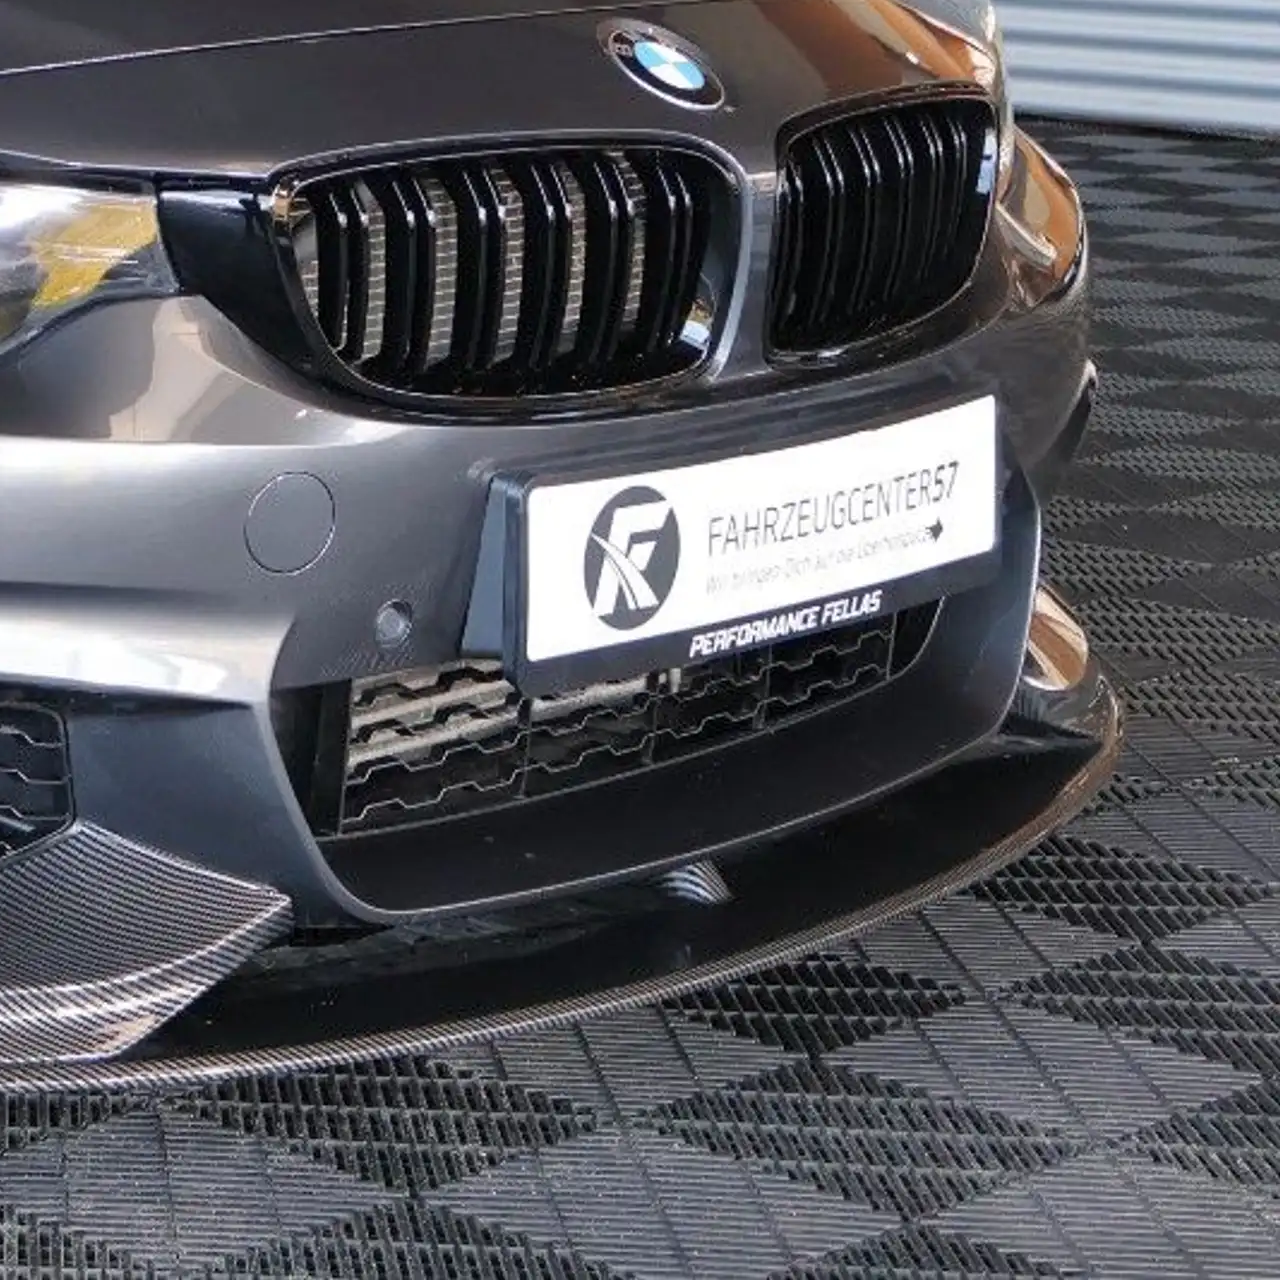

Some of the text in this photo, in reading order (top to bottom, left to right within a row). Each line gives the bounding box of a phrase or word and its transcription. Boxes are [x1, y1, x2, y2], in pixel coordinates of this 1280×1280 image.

[708, 460, 959, 557] FAHRZEUGCENTER57
[689, 589, 884, 658] PERFORMANCE FELLAS
